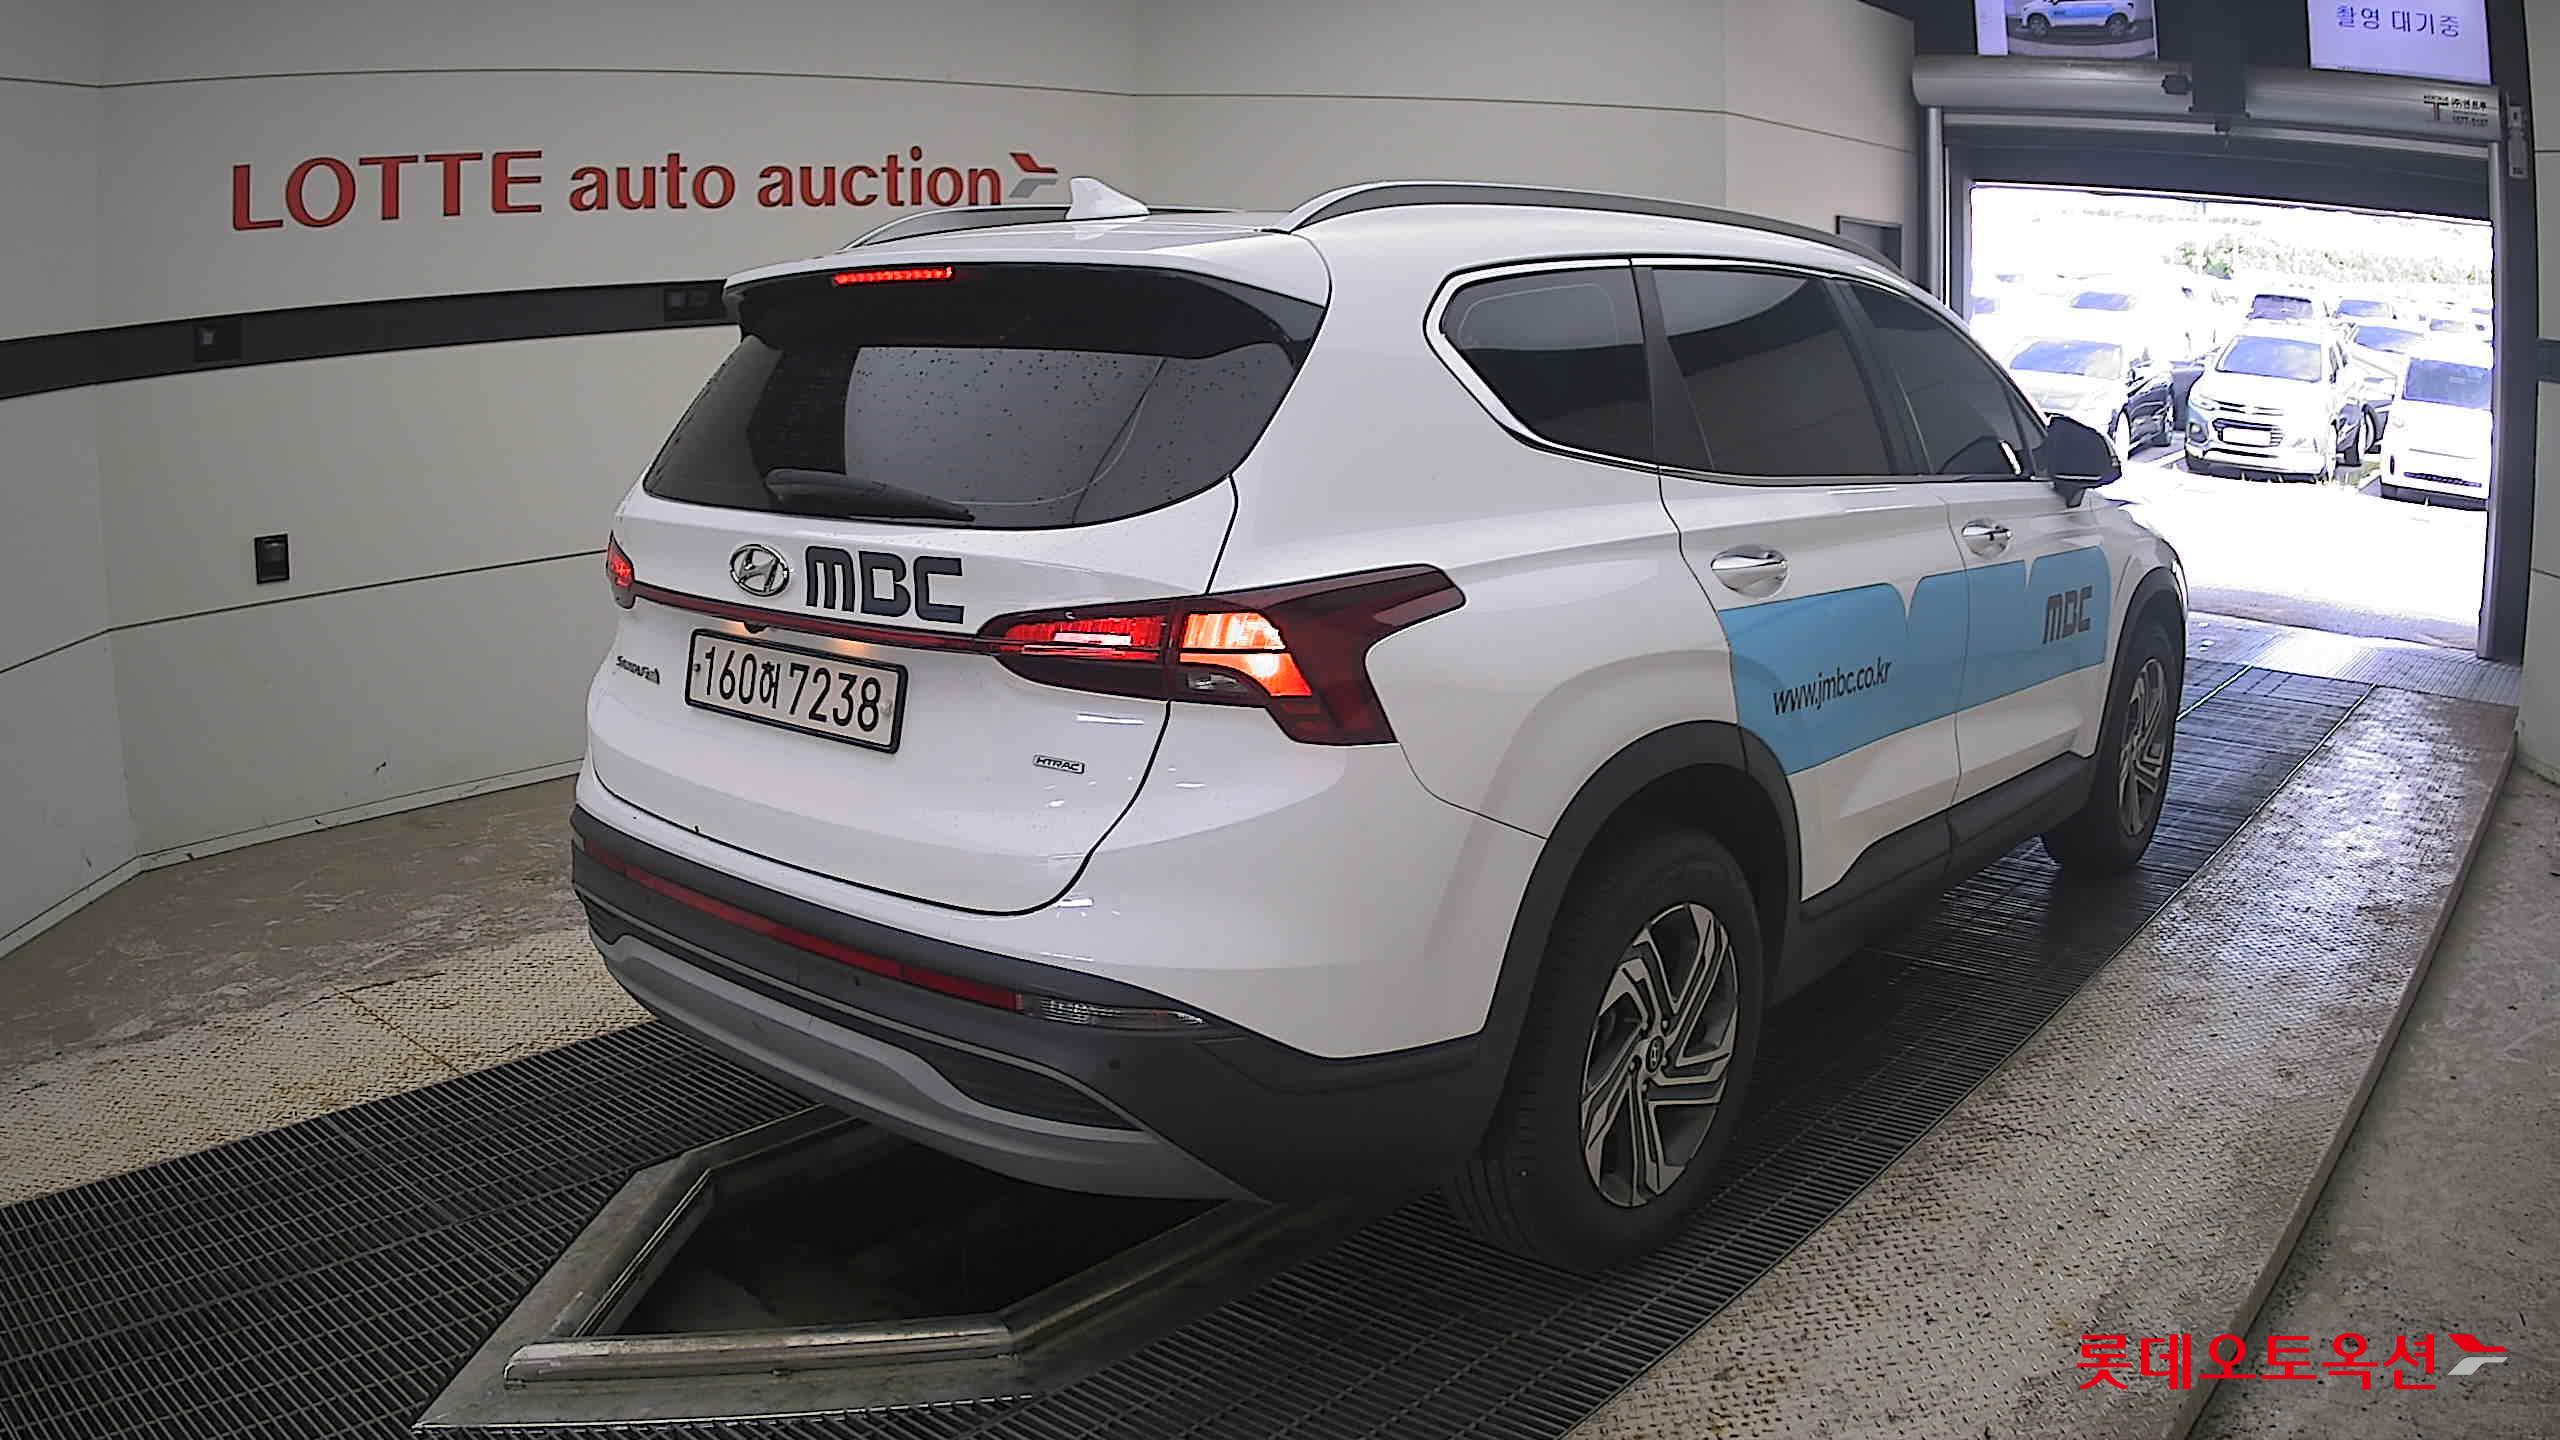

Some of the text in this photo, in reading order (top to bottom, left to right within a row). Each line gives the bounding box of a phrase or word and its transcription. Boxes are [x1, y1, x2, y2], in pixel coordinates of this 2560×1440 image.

[2391, 11, 2459, 38] 대기중
[232, 145, 1003, 232] LOTTE auto auction
[805, 545, 965, 624] MBC
[705, 646, 781, 709] 160허
[789, 662, 881, 732] 7238
[1773, 656, 1893, 716] www.jmbc.co.kr
[1036, 756, 1080, 771] HTRAC
